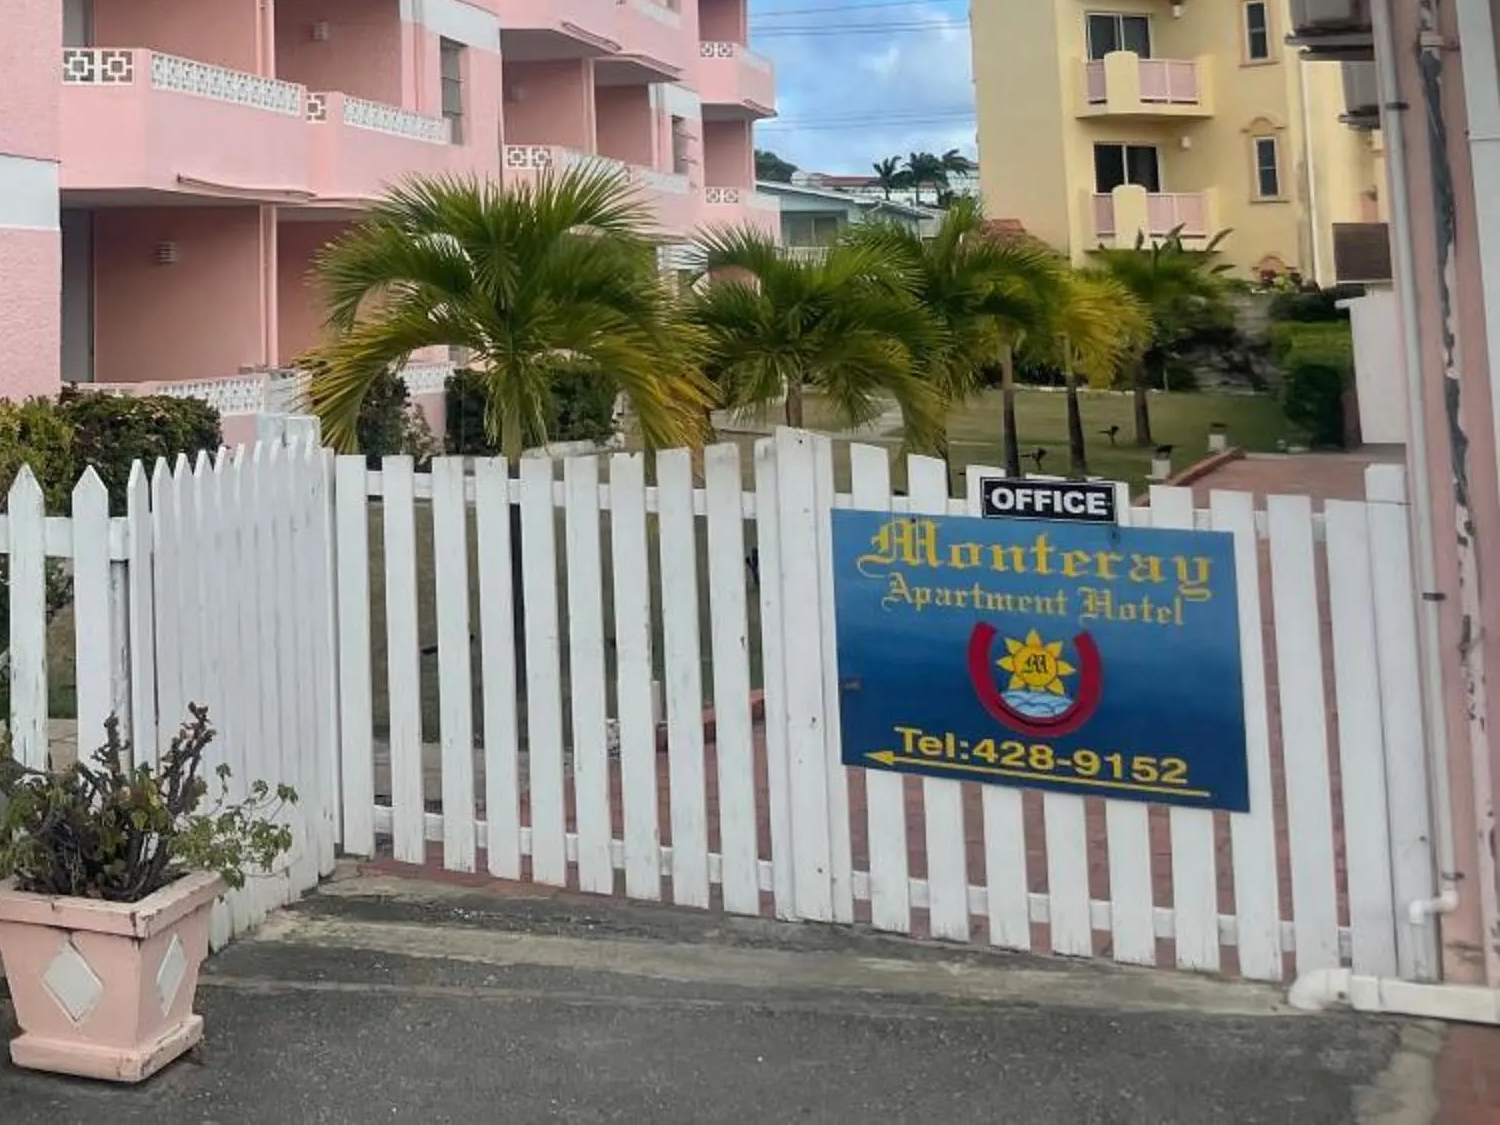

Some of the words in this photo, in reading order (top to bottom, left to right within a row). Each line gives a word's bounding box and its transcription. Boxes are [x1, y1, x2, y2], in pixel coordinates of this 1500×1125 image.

[989, 488, 1108, 516] OFFICE
[856, 518, 1212, 601] Monteray
[882, 572, 1068, 616] Apartment
[1076, 586, 1185, 626] Hotel
[893, 726, 1188, 785] Tel:428-9152
